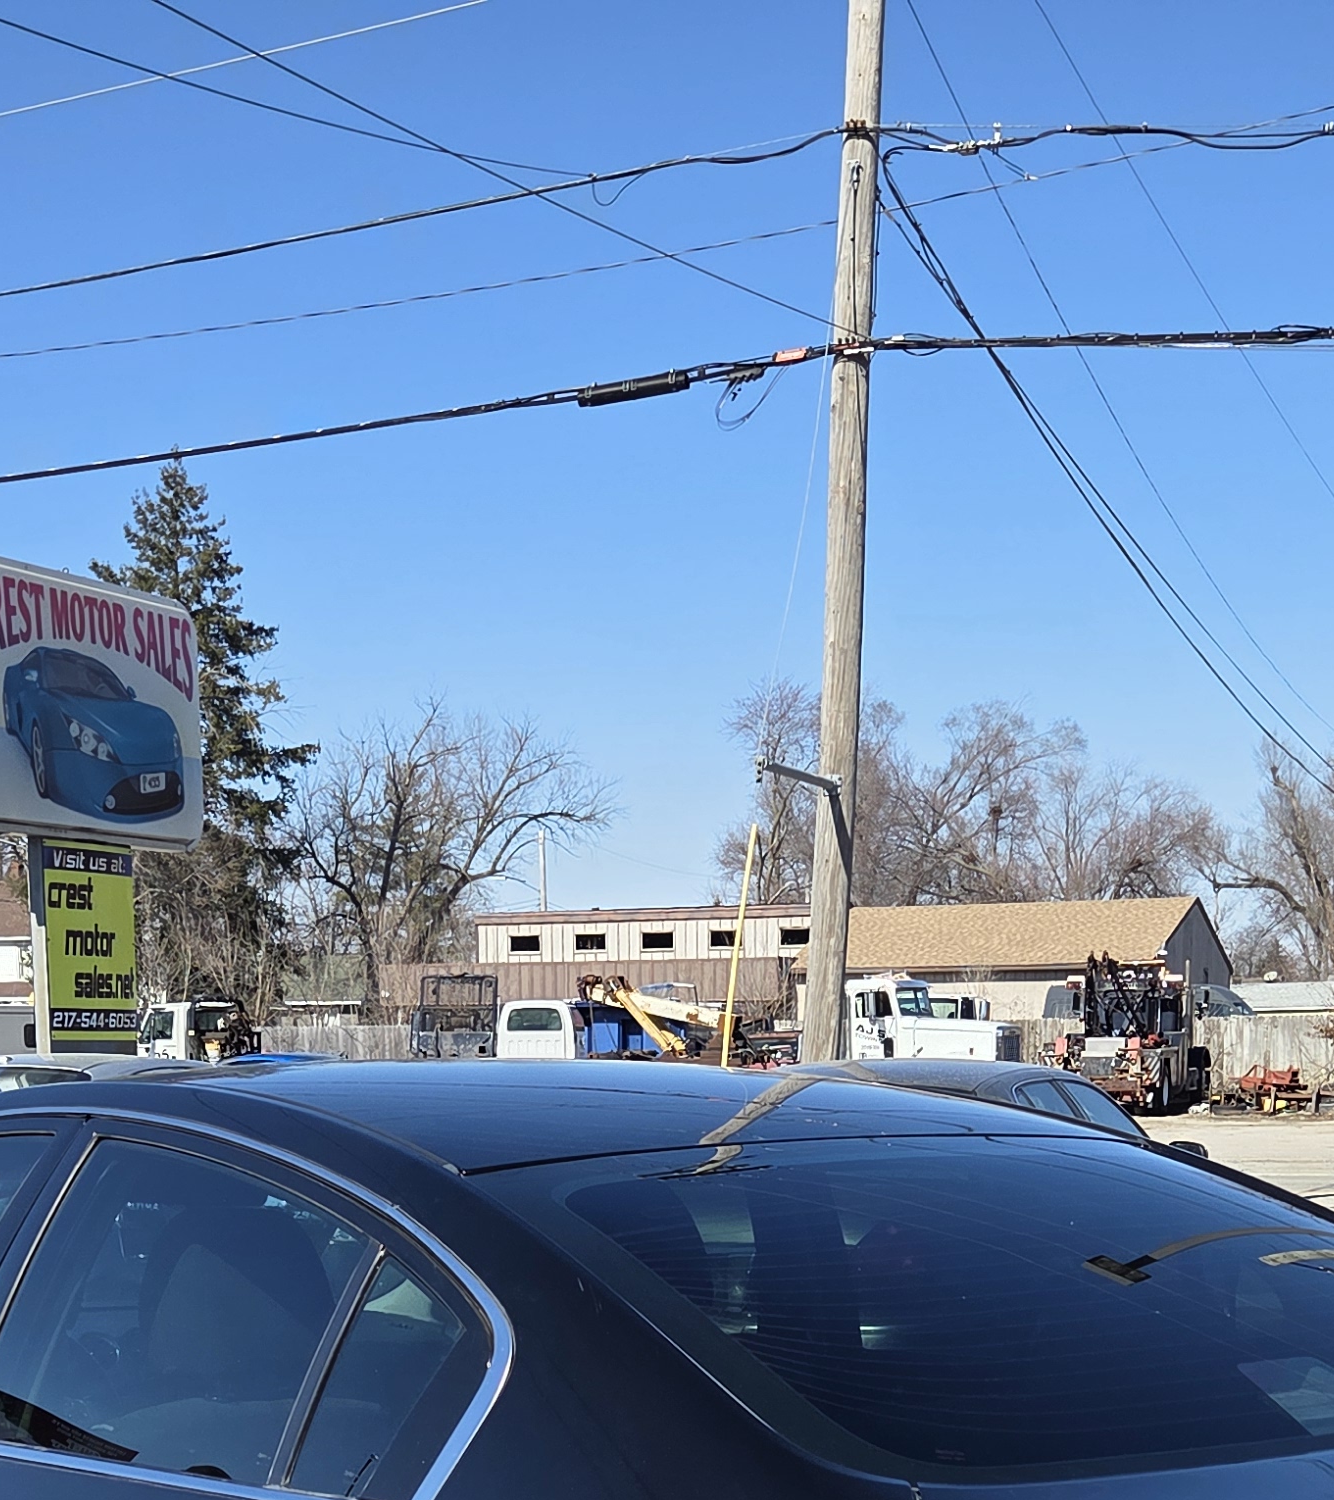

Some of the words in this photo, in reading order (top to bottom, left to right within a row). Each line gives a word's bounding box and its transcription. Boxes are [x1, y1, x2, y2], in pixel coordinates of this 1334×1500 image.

[49, 587, 129, 656] MOTOR
[132, 606, 193, 702] SALES
[53, 849, 85, 869] Visit
[89, 854, 107, 872] us
[110, 855, 126, 874] at:
[48, 877, 94, 911] crest
[64, 923, 116, 958] motor
[74, 965, 135, 1000] sales.net
[52, 1011, 137, 1029] 217-544-6053
